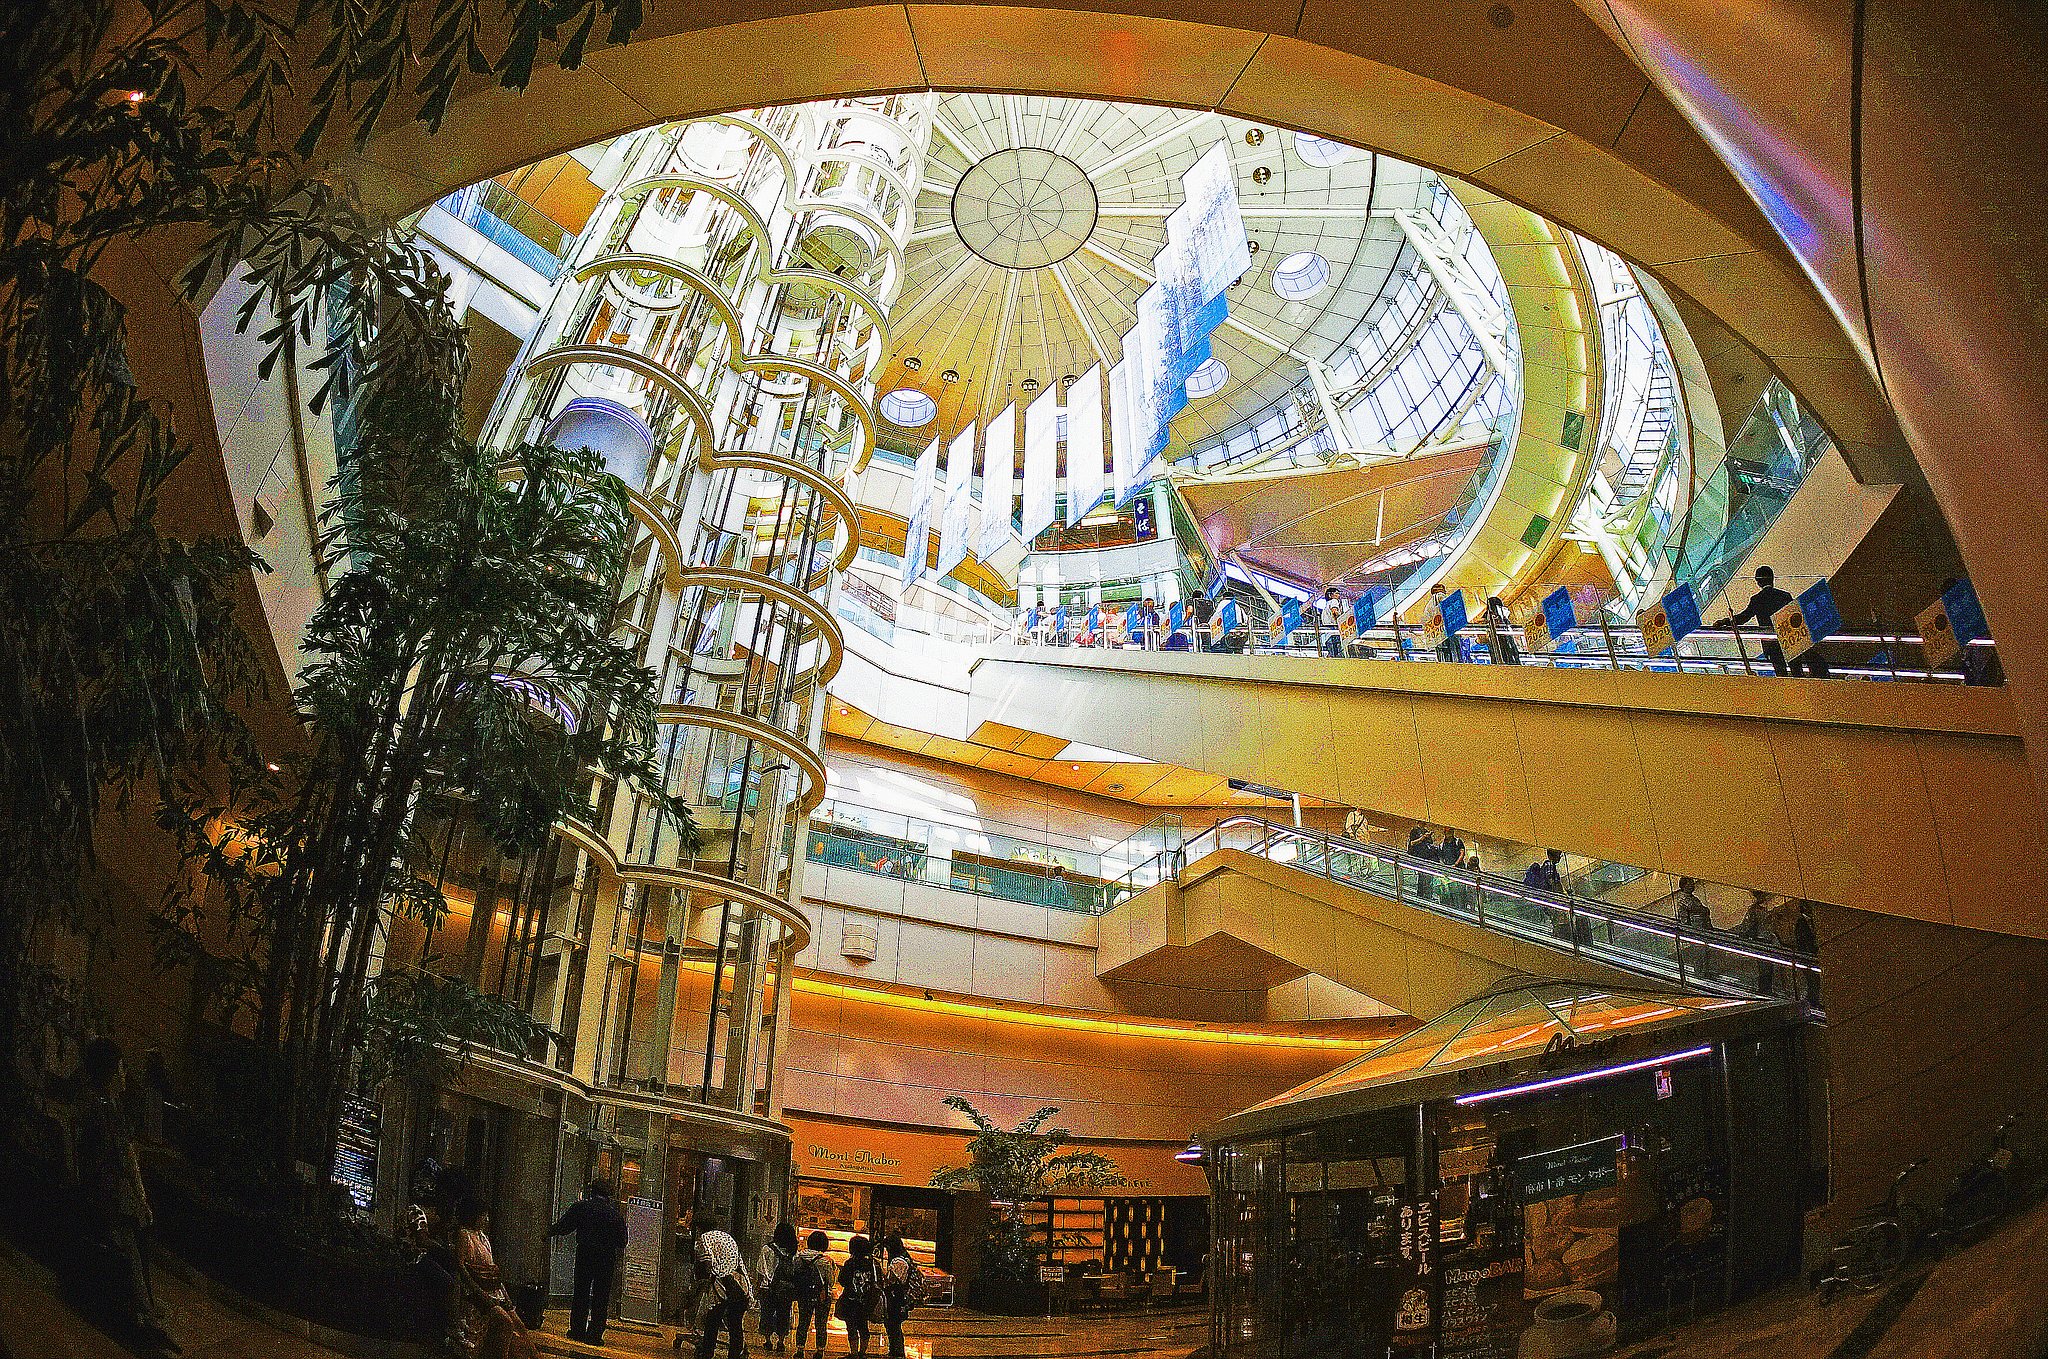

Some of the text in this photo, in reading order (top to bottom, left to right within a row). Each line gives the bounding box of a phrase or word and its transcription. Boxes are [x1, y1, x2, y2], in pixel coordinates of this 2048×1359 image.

[1137, 502, 1150, 533] そば
[1646, 626, 1672, 649] 2020
[1782, 626, 1808, 650] 2020
